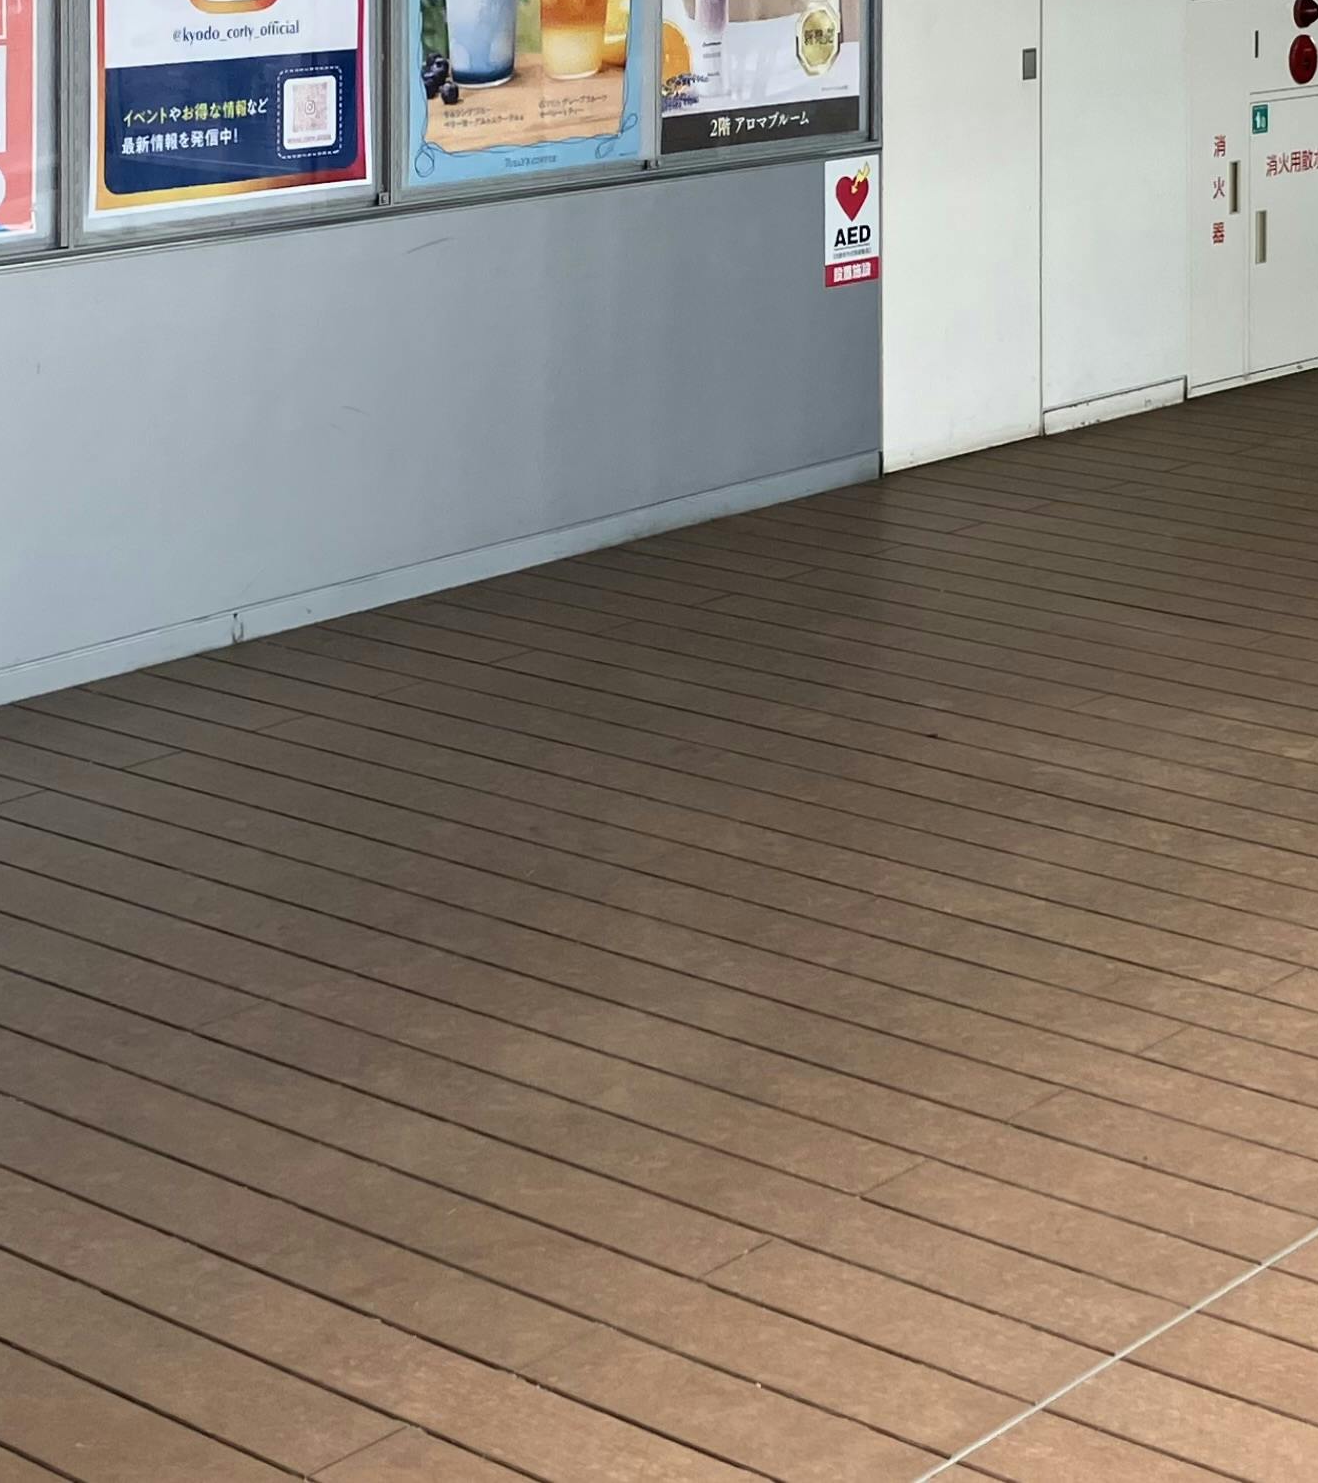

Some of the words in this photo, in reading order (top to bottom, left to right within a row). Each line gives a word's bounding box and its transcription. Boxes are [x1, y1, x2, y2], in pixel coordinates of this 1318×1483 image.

[173, 20, 300, 46] @kyodo_corty_official
[123, 98, 269, 128] イベントやお得な情報など
[121, 128, 239, 155] 最新情報を発信中！
[834, 225, 871, 248] AED
